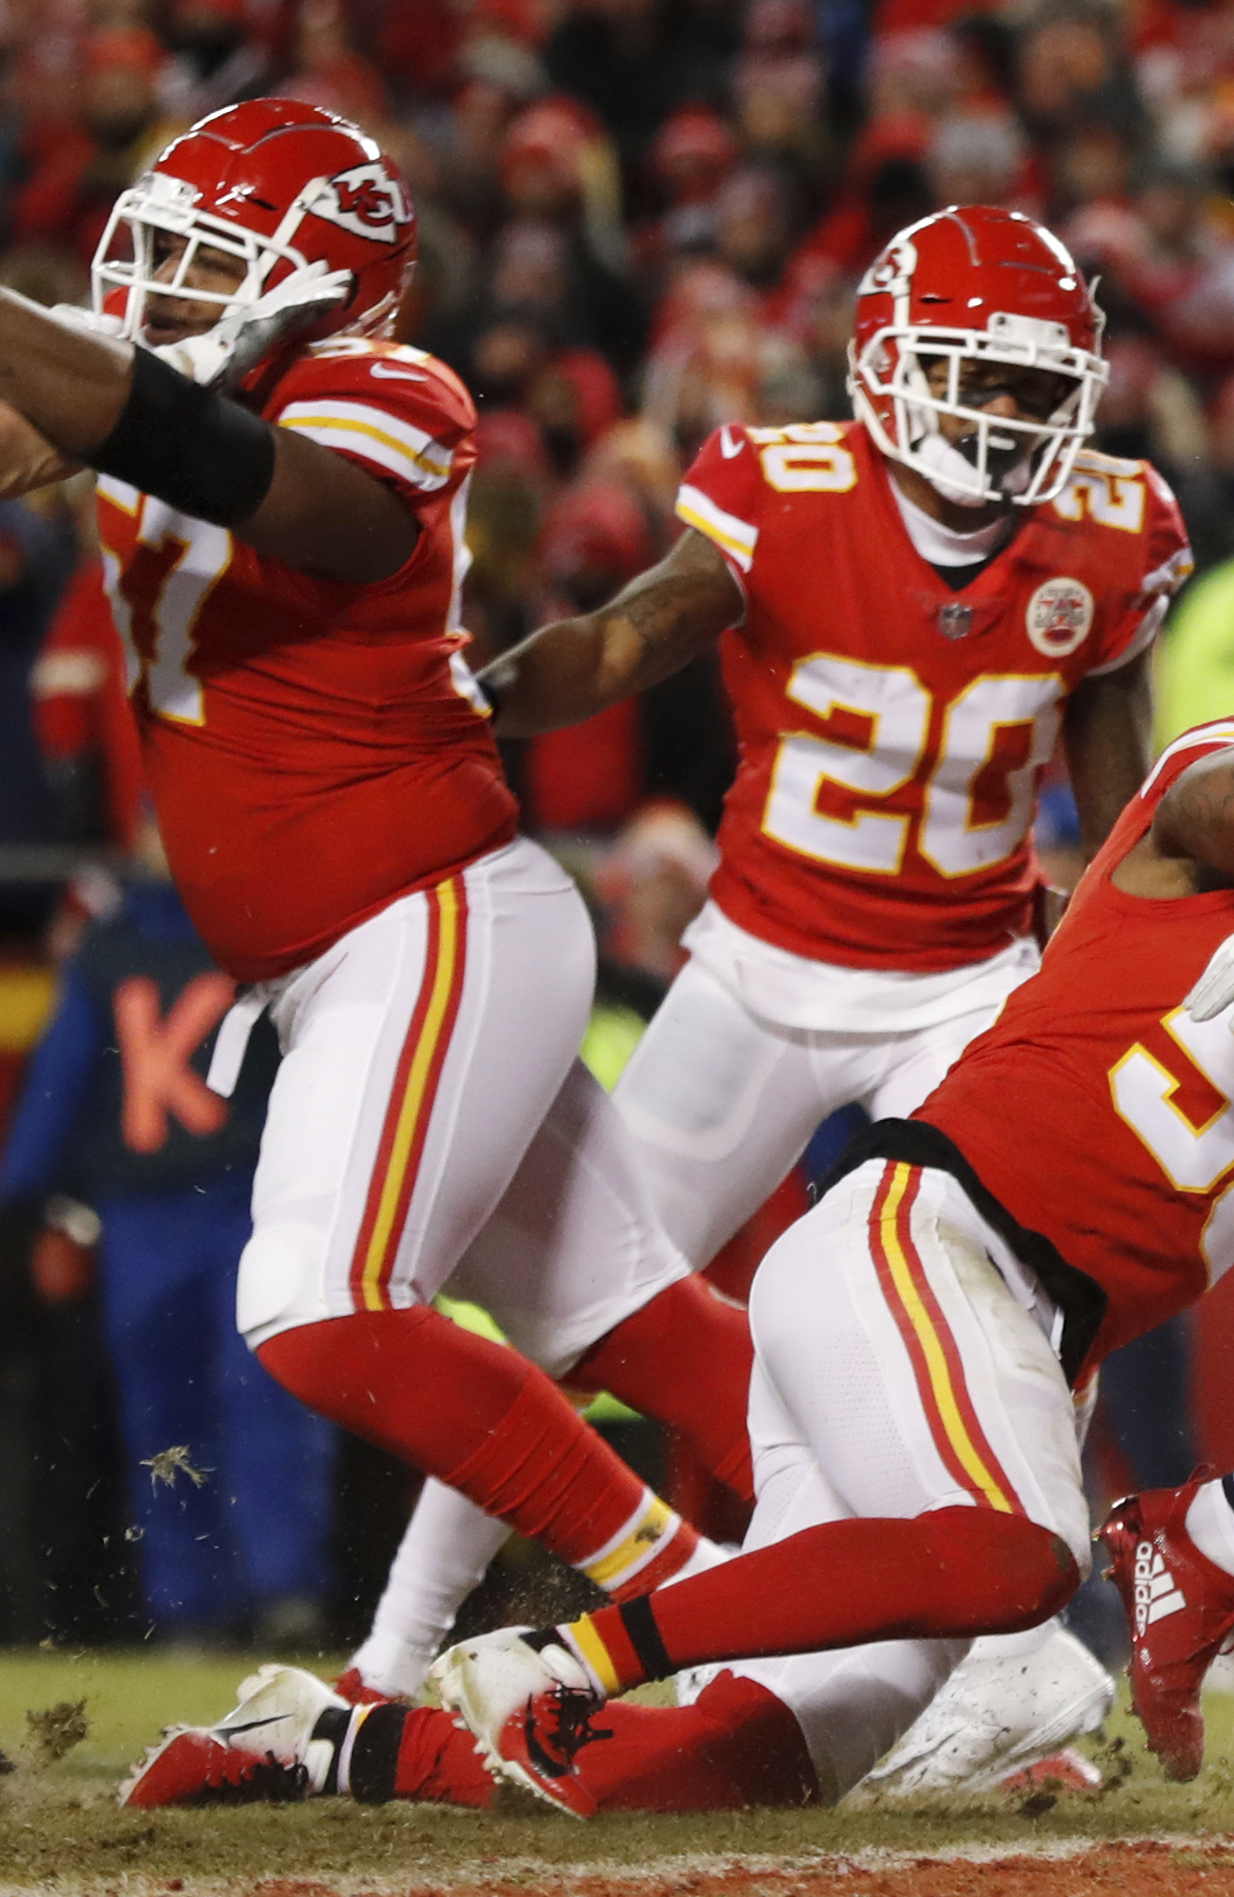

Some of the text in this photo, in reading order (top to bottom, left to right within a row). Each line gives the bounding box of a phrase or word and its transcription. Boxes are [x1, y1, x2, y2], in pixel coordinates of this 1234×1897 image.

[332, 179, 396, 227] KC
[760, 651, 1068, 880] 20
[113, 971, 238, 1156] K
[1134, 1541, 1153, 1637] adidas
